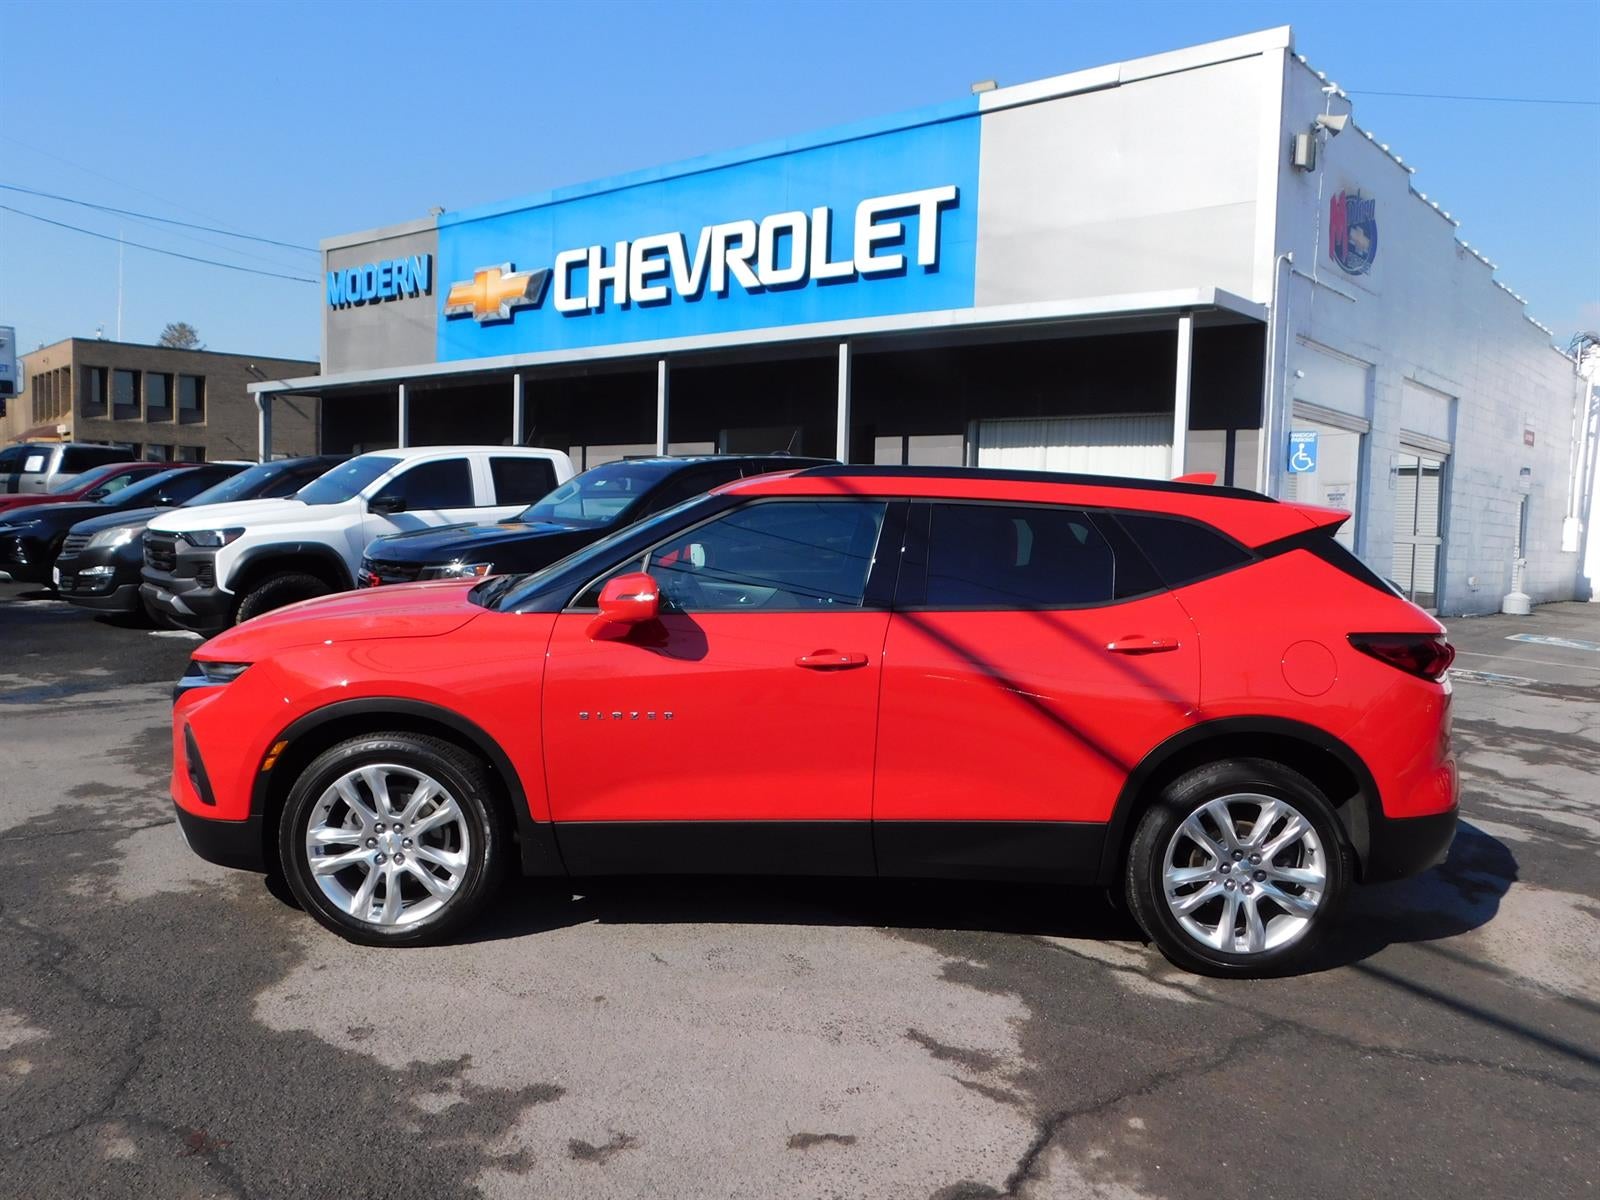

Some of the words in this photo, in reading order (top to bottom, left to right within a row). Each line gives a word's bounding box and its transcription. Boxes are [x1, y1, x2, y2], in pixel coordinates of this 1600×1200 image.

[554, 185, 957, 313] CHEVROLET
[327, 254, 431, 307] MODERN
[579, 711, 674, 720] BLAZER
